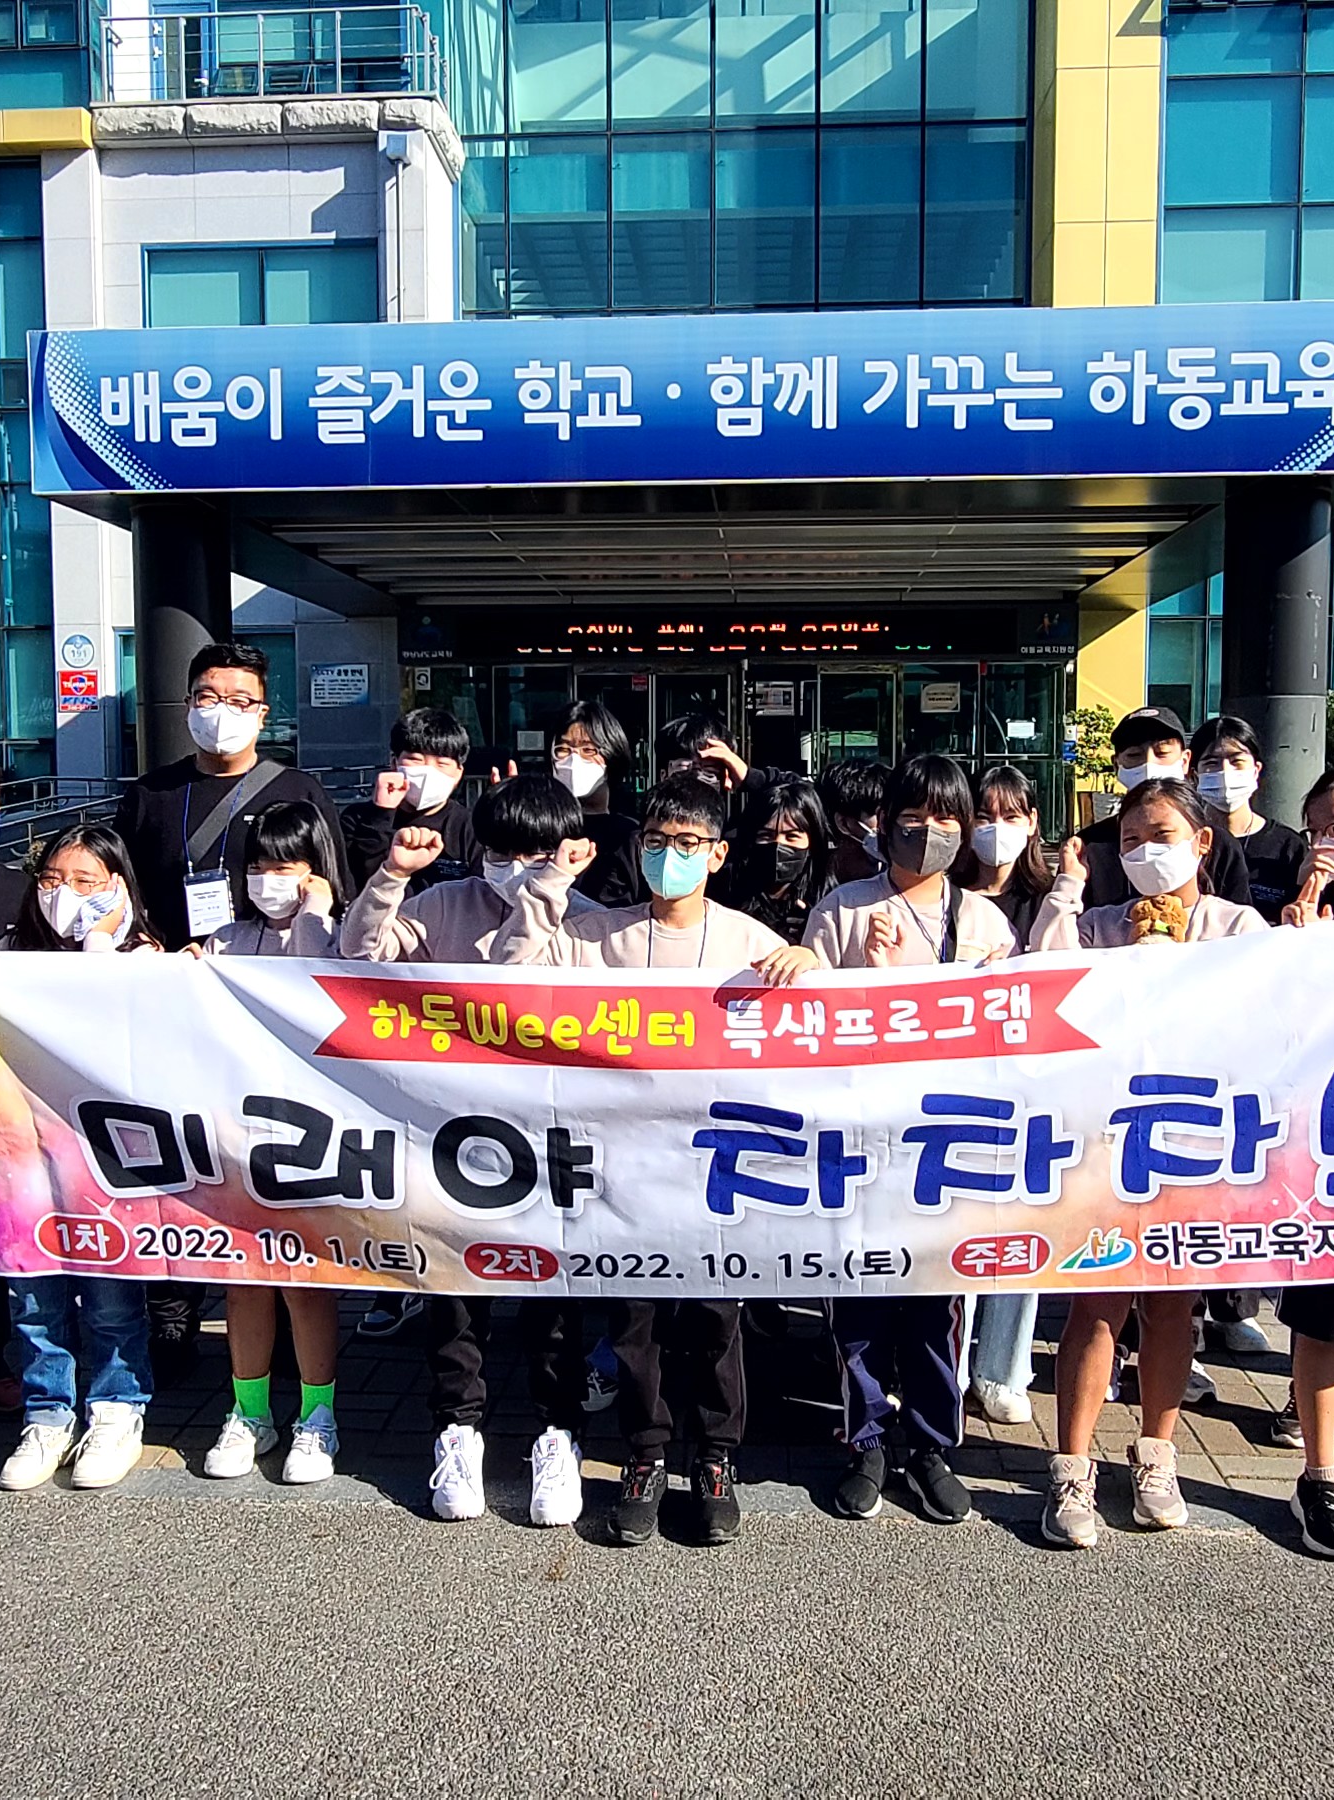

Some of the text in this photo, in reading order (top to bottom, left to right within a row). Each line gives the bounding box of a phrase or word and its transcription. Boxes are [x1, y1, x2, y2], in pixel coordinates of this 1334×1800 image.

[100, 364, 282, 448] 배움이
[308, 359, 493, 444] 즐거운
[514, 359, 643, 441] 학교
[706, 354, 839, 438] 함께
[861, 350, 1064, 432] 가꾸는
[368, 983, 1032, 1059] 하동Wee센터 특색프로그램
[77, 1095, 595, 1212] 미래야
[56, 1223, 111, 1259] 1차
[136, 1227, 245, 1264] 2022.
[258, 1230, 318, 1267] 10.
[480, 1248, 544, 1279] 2차
[568, 1252, 686, 1280] 2022.
[701, 1252, 761, 1281] 10.
[961, 1237, 1039, 1274] 주최
